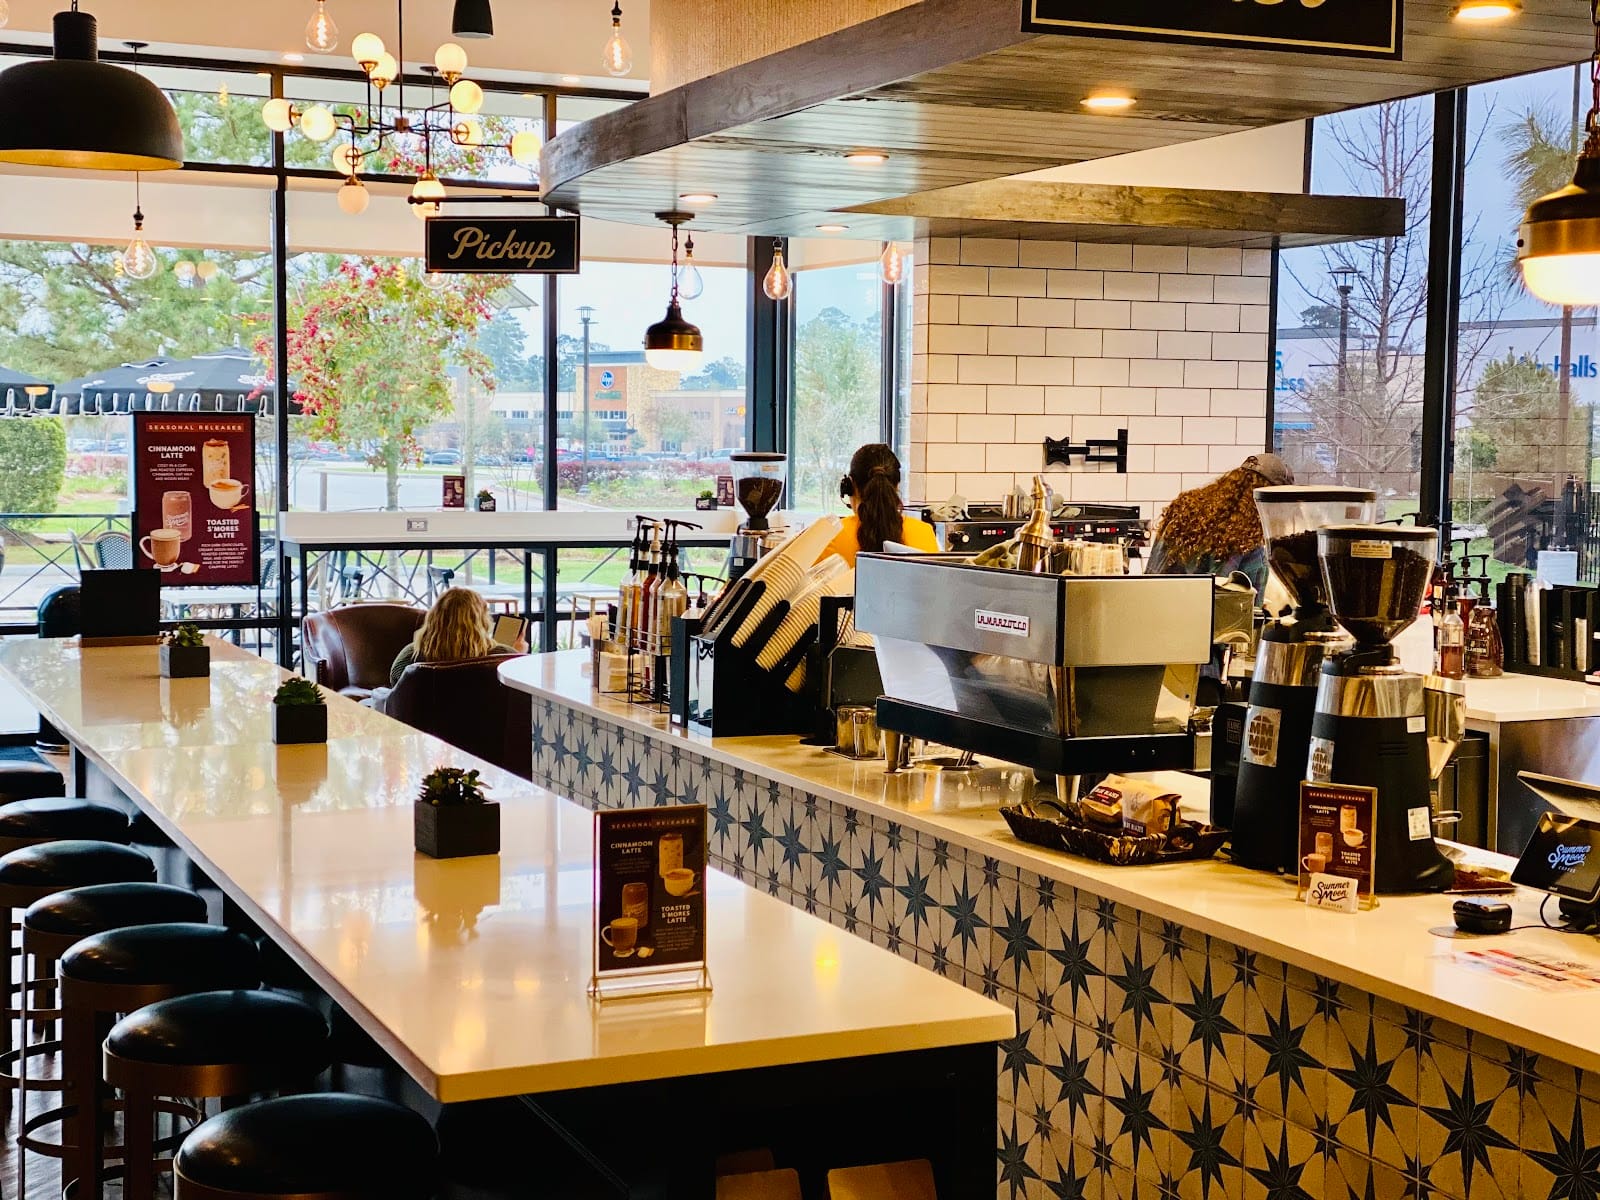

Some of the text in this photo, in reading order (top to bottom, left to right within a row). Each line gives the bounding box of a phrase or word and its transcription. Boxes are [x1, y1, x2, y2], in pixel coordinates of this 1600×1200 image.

[447, 226, 556, 268] Pickup
[148, 445, 196, 453] CINNAMOON
[610, 840, 653, 849] CINNAMOON
[621, 847, 642, 855] LATTE
[661, 904, 691, 912] TOASTED
[661, 911, 690, 919] S'MORES
